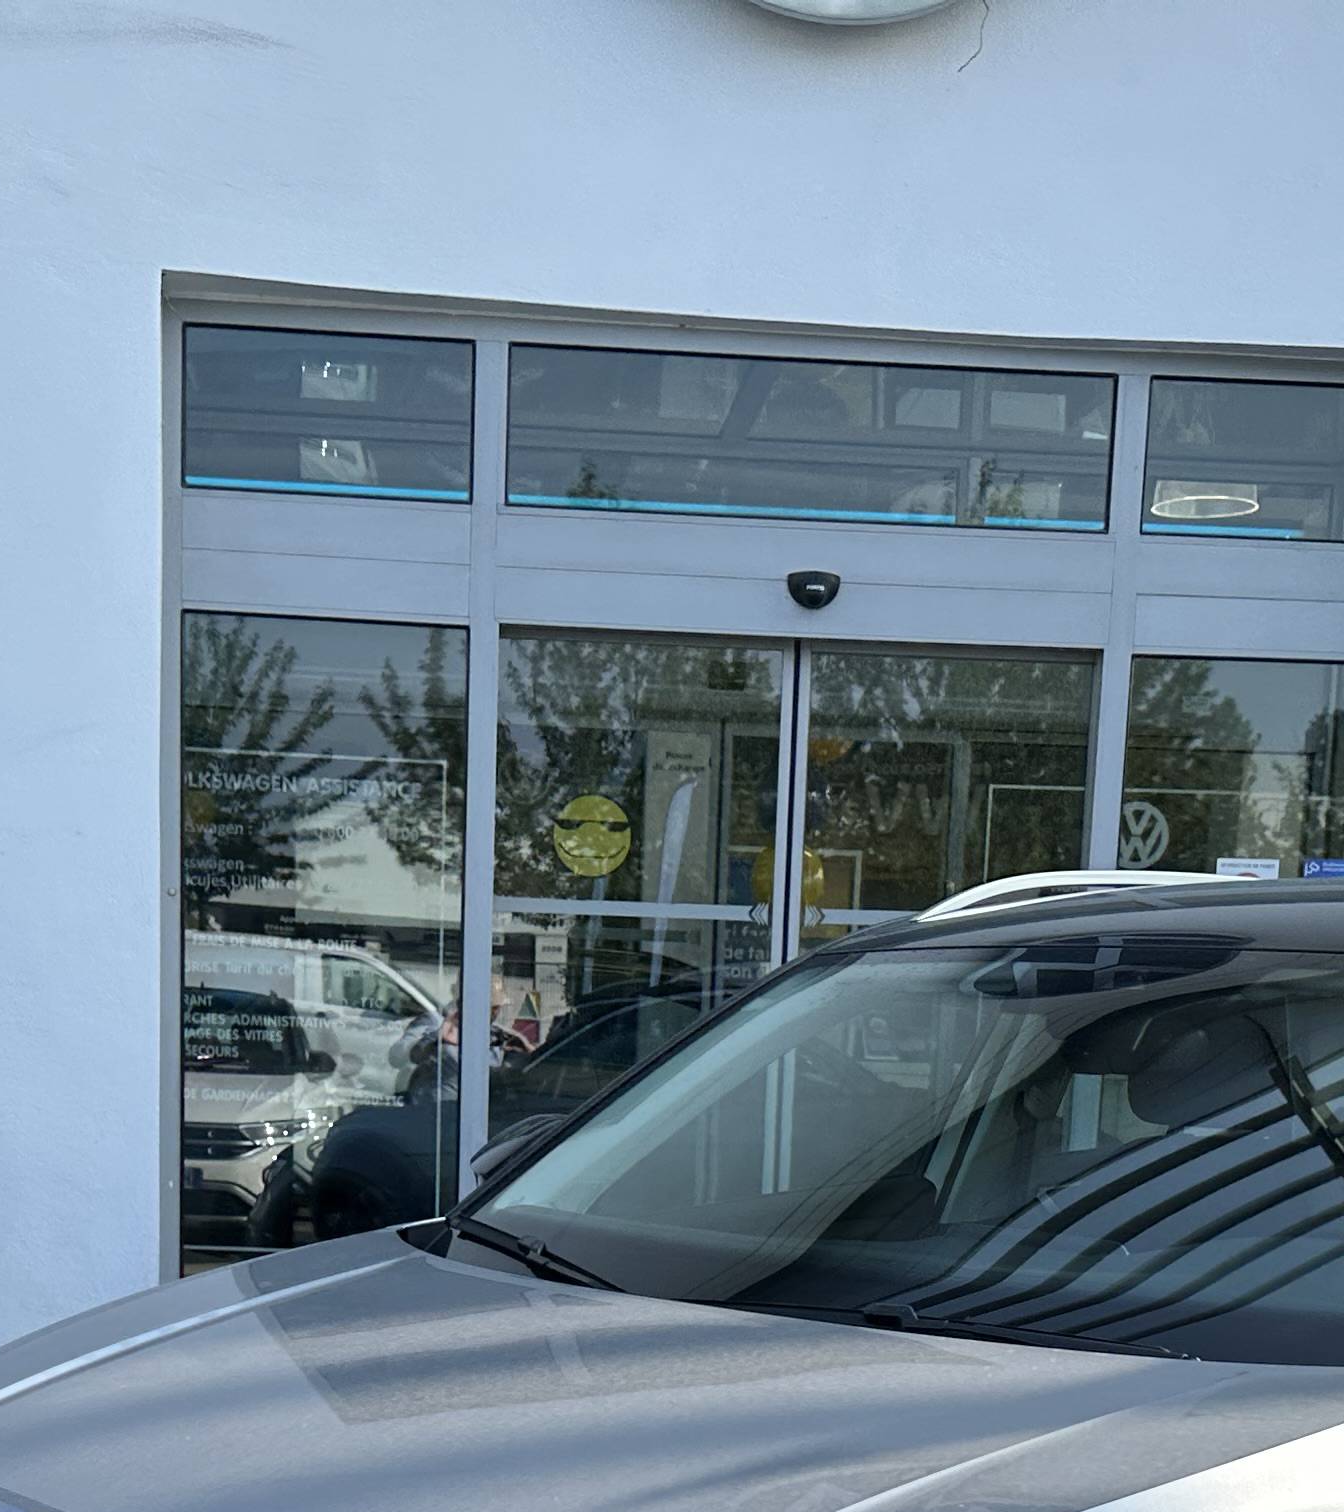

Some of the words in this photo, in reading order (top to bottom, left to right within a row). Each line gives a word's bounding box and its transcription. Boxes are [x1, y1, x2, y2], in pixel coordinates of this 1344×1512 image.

[184, 771, 296, 792] LKSWAGEN
[217, 1028, 240, 1041] DES
[244, 1029, 284, 1043] VITRES
[185, 1044, 240, 1059] SECOURS
